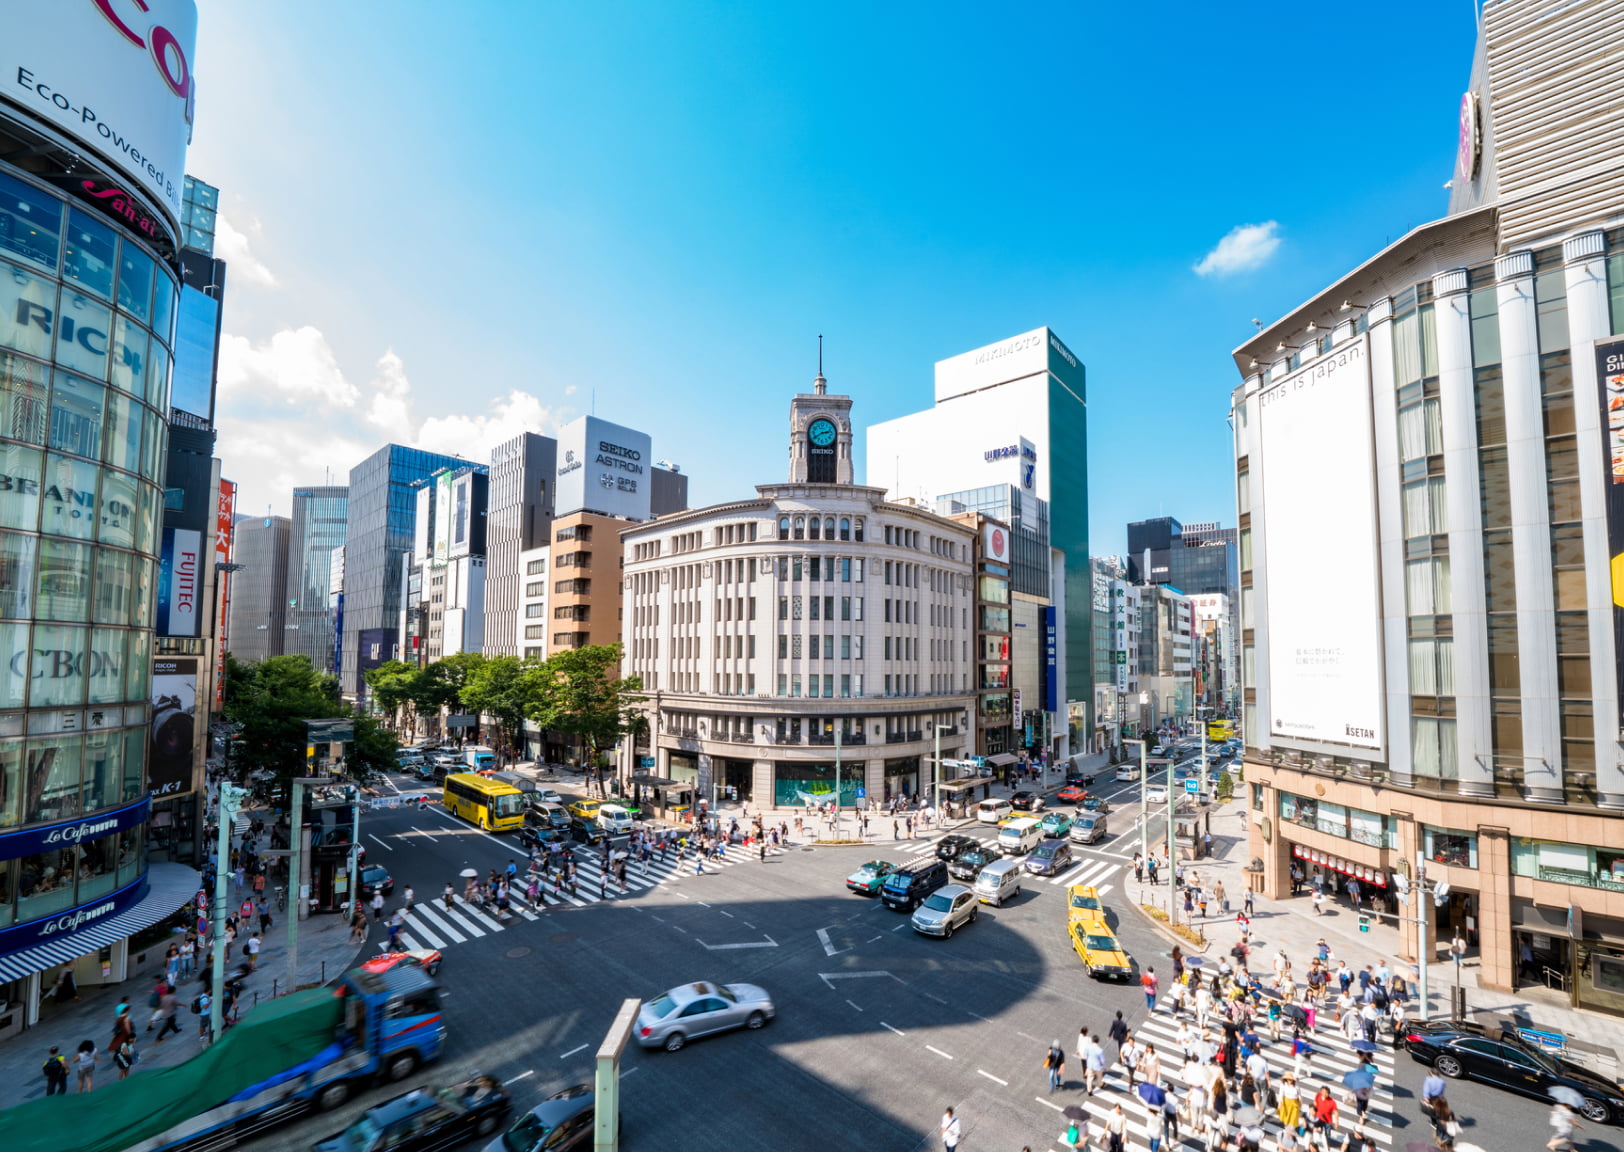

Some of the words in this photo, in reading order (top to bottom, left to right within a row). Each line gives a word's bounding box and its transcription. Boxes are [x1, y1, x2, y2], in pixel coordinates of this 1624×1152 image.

[974, 336, 1041, 366] MIKIMOTO
[1050, 336, 1077, 368] MIKIMOTO
[1261, 384, 1287, 408] this
[1293, 375, 1305, 391] is
[599, 441, 641, 461] SEIKO
[595, 453, 643, 475] ASTRON
[617, 477, 637, 488] GPS
[174, 551, 196, 613] FUJITEC
[161, 780, 182, 794] K-1
[42, 830, 61, 844] Le
[38, 920, 57, 936] Le
